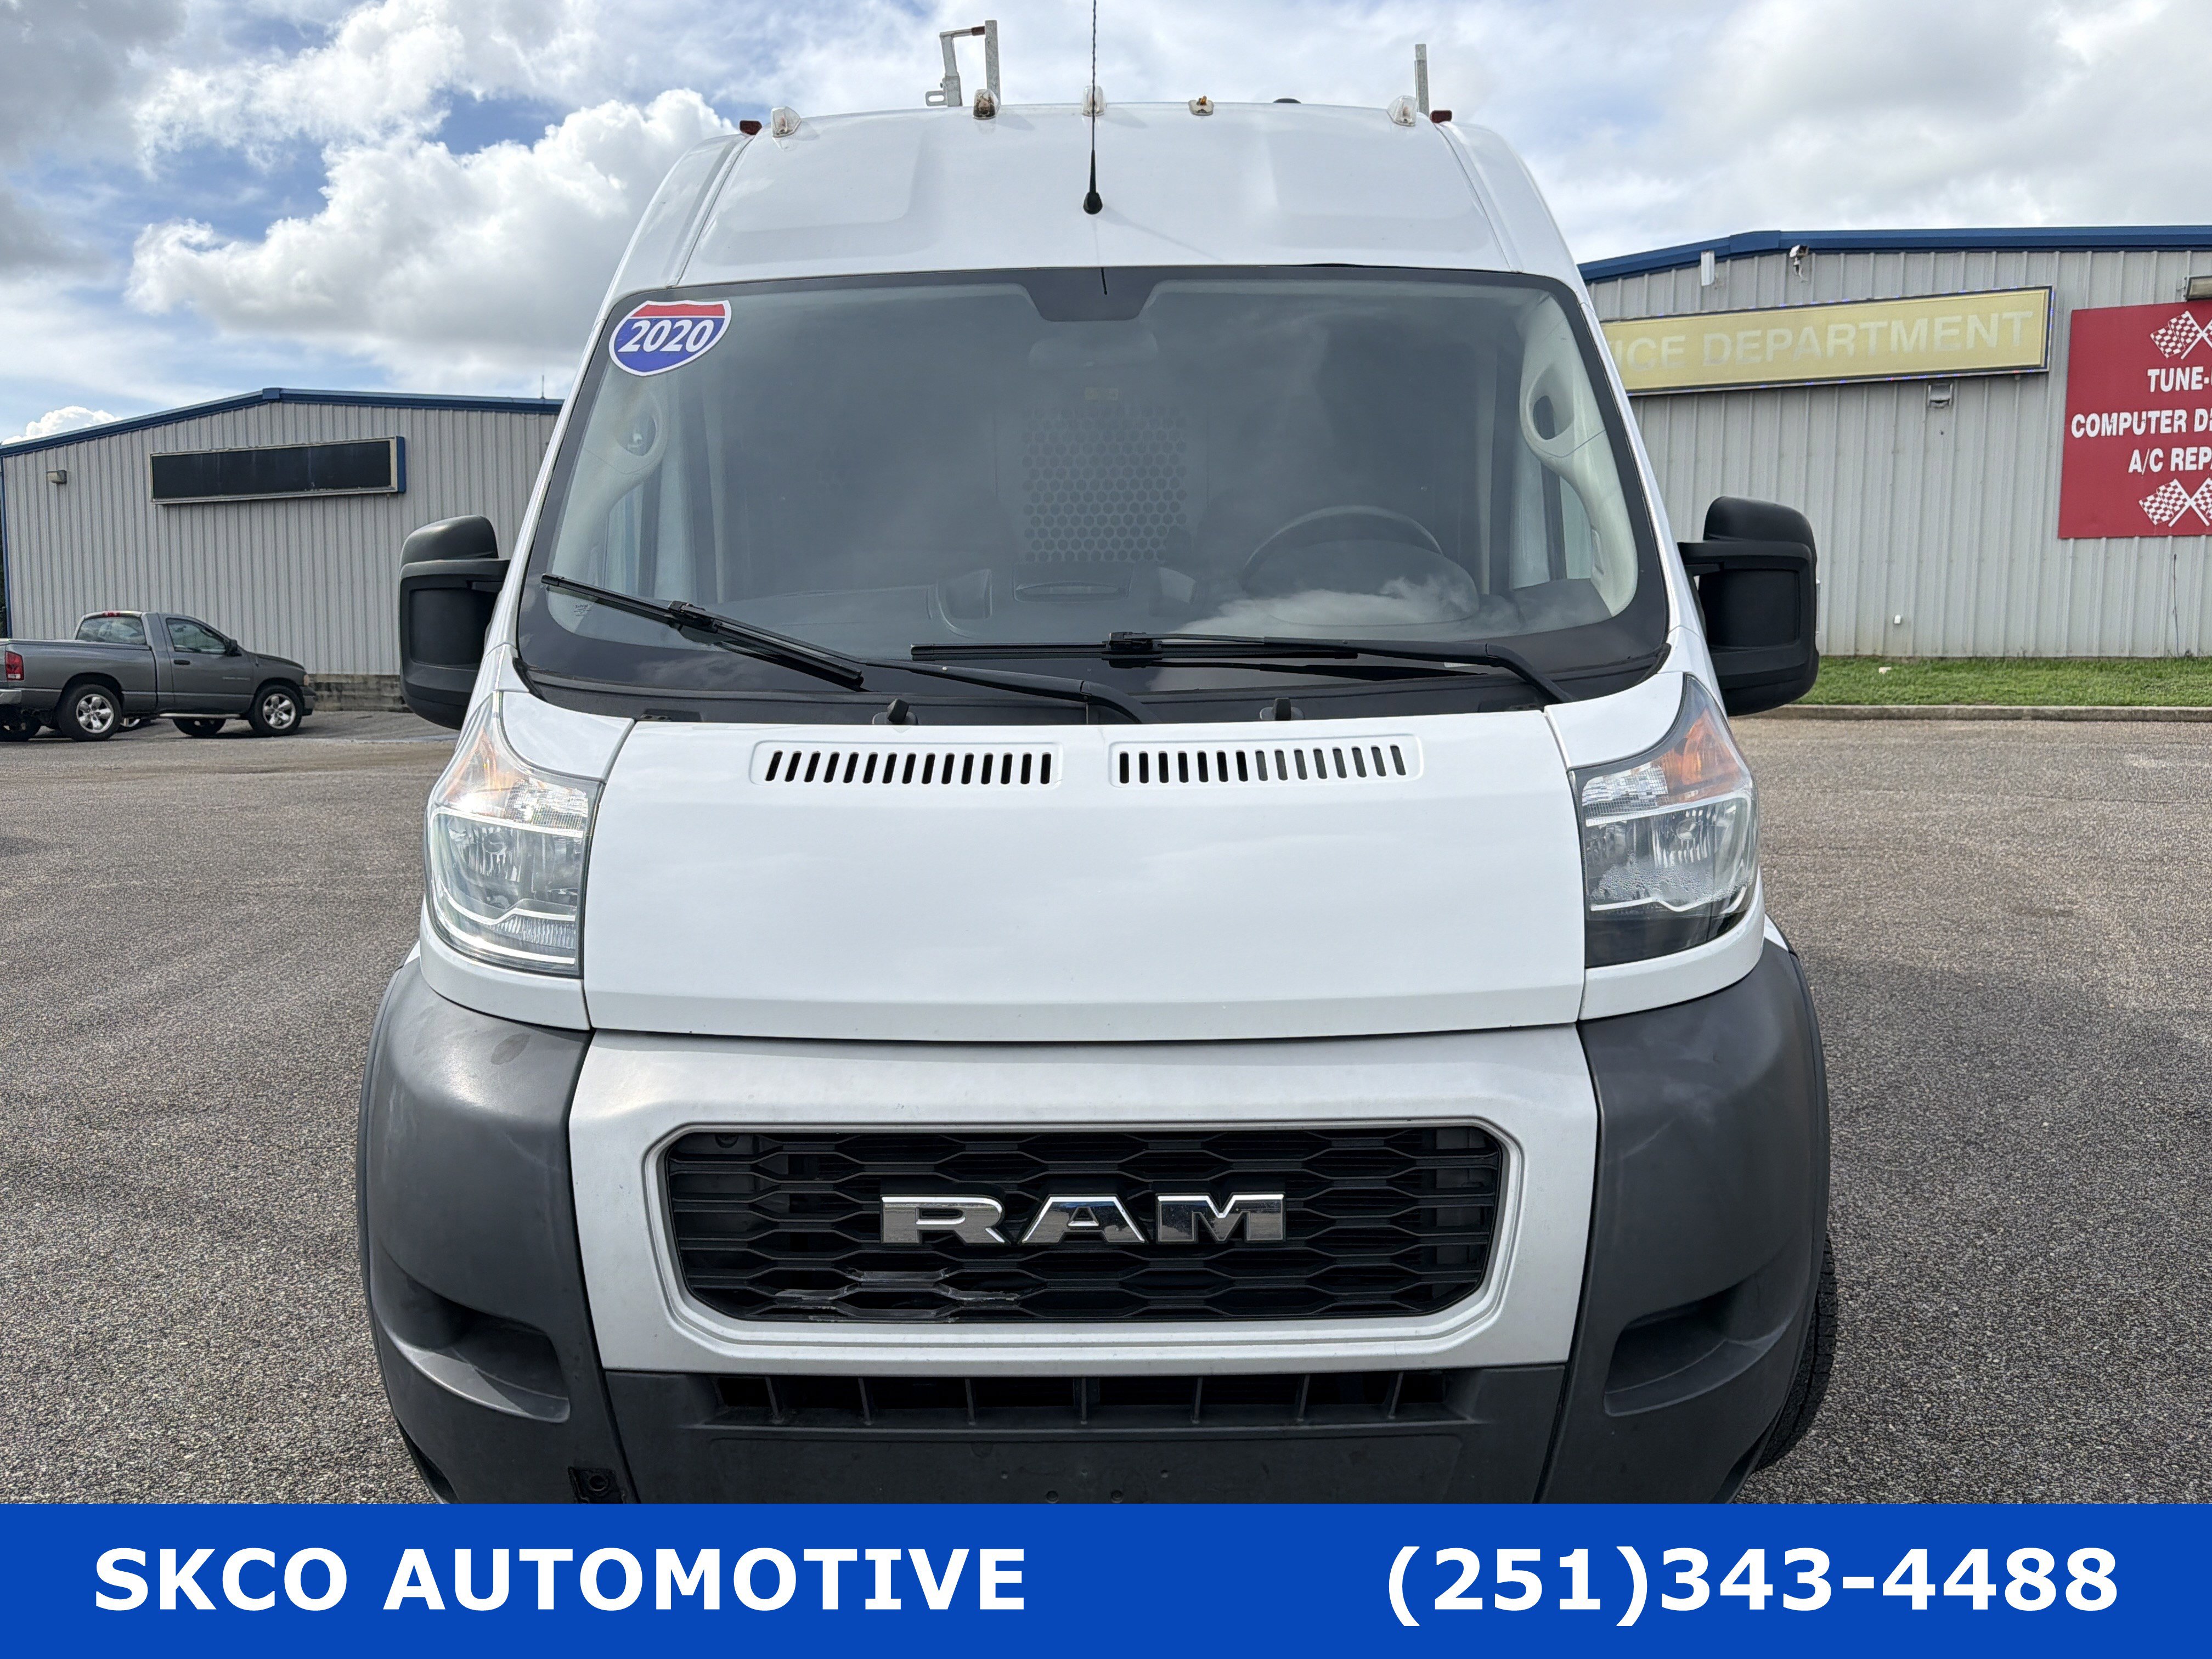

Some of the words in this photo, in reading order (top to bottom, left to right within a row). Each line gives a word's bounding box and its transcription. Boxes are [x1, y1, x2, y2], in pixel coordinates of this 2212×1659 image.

[618, 320, 714, 352] 2020
[1609, 335, 1686, 372] ICE
[1703, 311, 2033, 366] DEPARTMENT
[2147, 366, 2212, 392] TUNE-
[2071, 410, 2187, 438] COMPUTER
[2128, 448, 2164, 476] A/C
[2170, 447, 2212, 471] REP
[881, 1194, 1285, 1244] RAM
